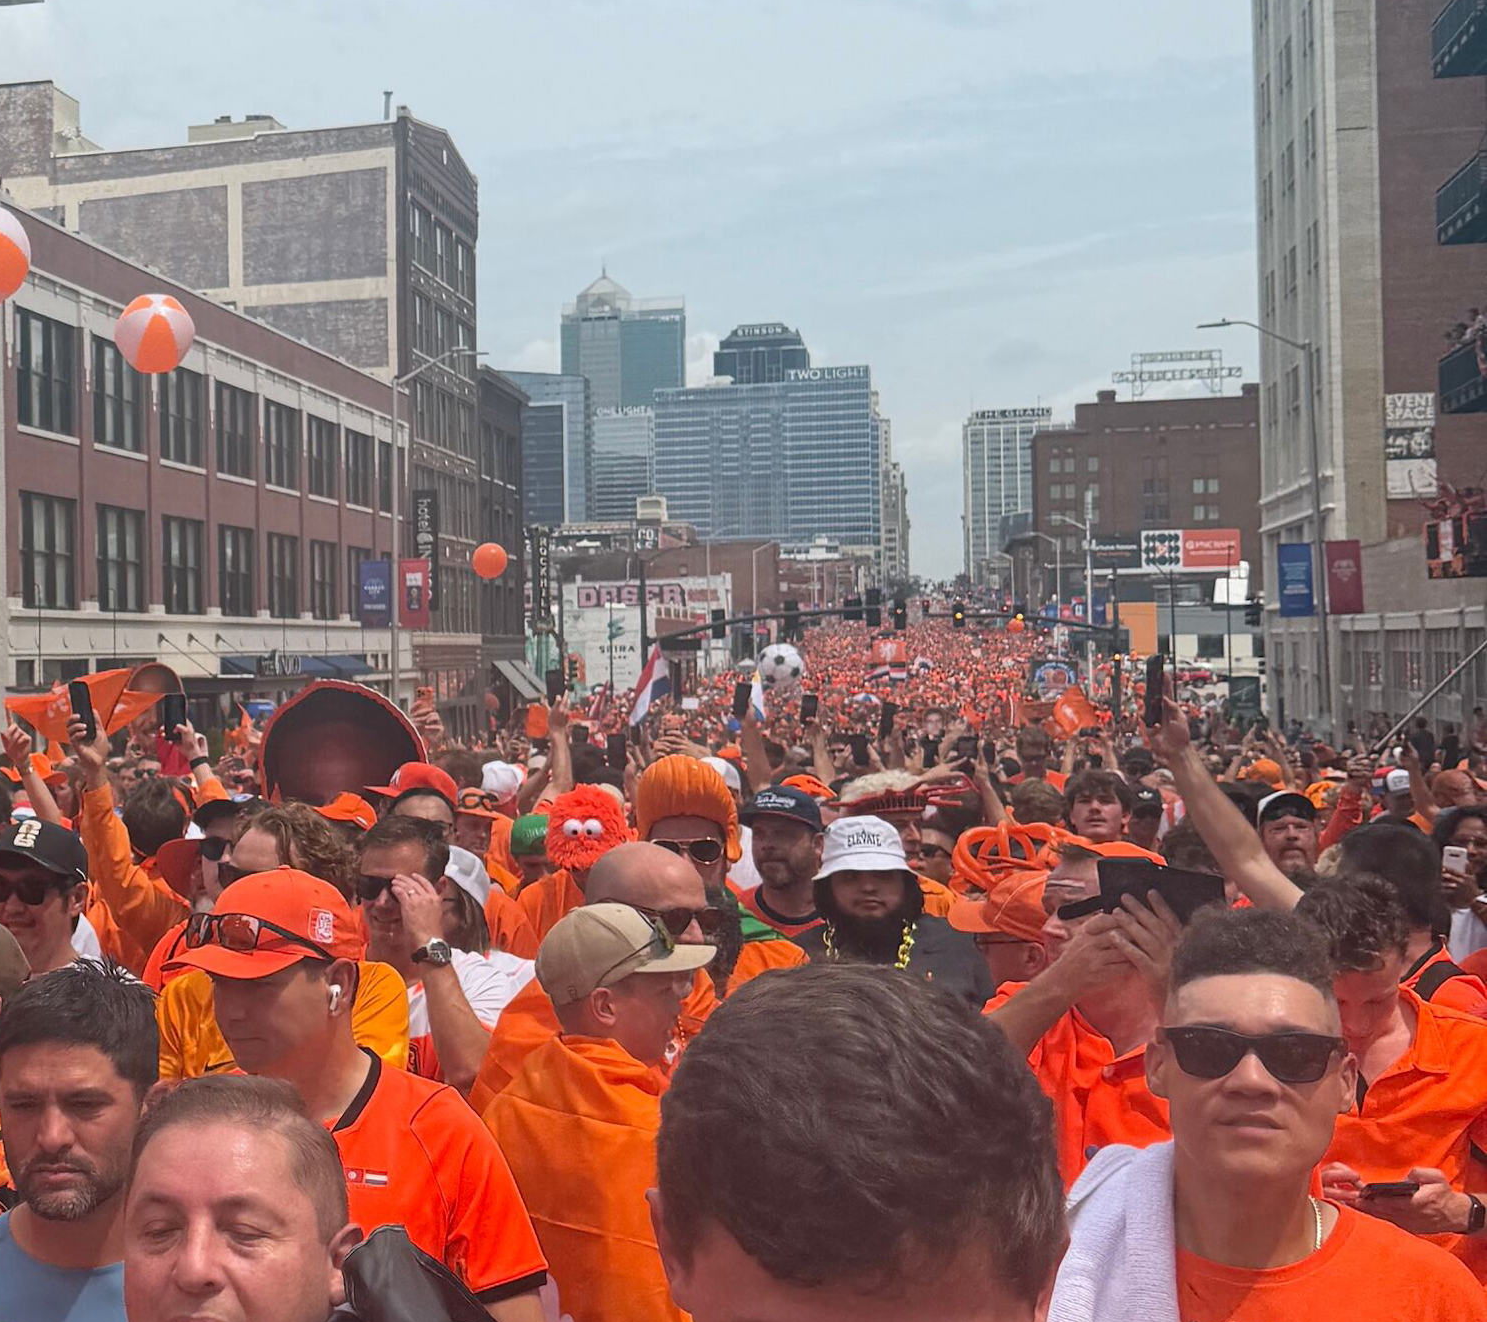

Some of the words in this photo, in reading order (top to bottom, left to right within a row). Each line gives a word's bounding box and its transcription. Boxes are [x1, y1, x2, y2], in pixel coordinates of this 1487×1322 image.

[736, 326, 783, 336] STINSON
[788, 369, 820, 381] TWO
[824, 367, 865, 380] LIGHT
[1386, 393, 1434, 407] EVENT
[1386, 407, 1434, 420] SPACE
[417, 498, 433, 532] hotel
[846, 831, 882, 848] ELEVATE
